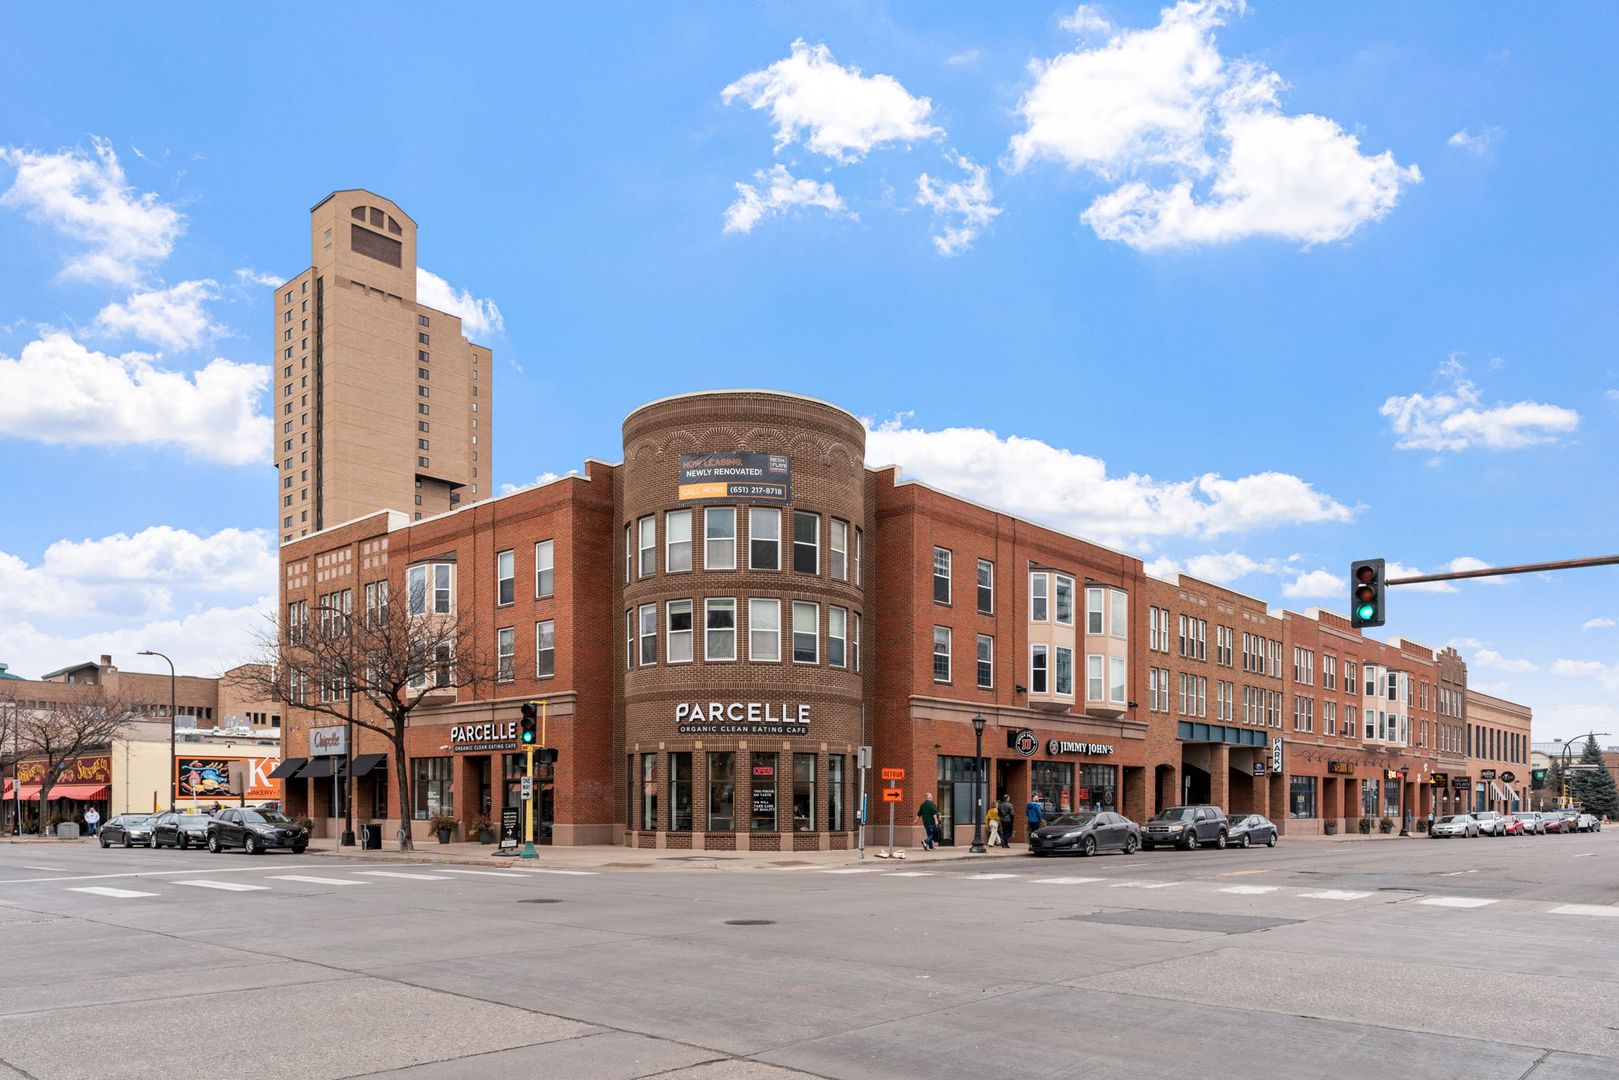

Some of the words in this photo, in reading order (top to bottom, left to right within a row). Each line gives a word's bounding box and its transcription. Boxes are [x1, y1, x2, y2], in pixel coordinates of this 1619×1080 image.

[686, 468, 712, 477] NEWLY
[714, 468, 763, 476] RENOVATED!
[730, 486, 748, 494] (651)
[751, 486, 783, 496] 217-8718
[675, 702, 811, 724] PARCELLE
[450, 722, 516, 743] PARCELLE
[1060, 741, 1087, 754] JIMMY
[1088, 744, 1114, 756] JOHN'S
[883, 770, 903, 778] DETOUR
